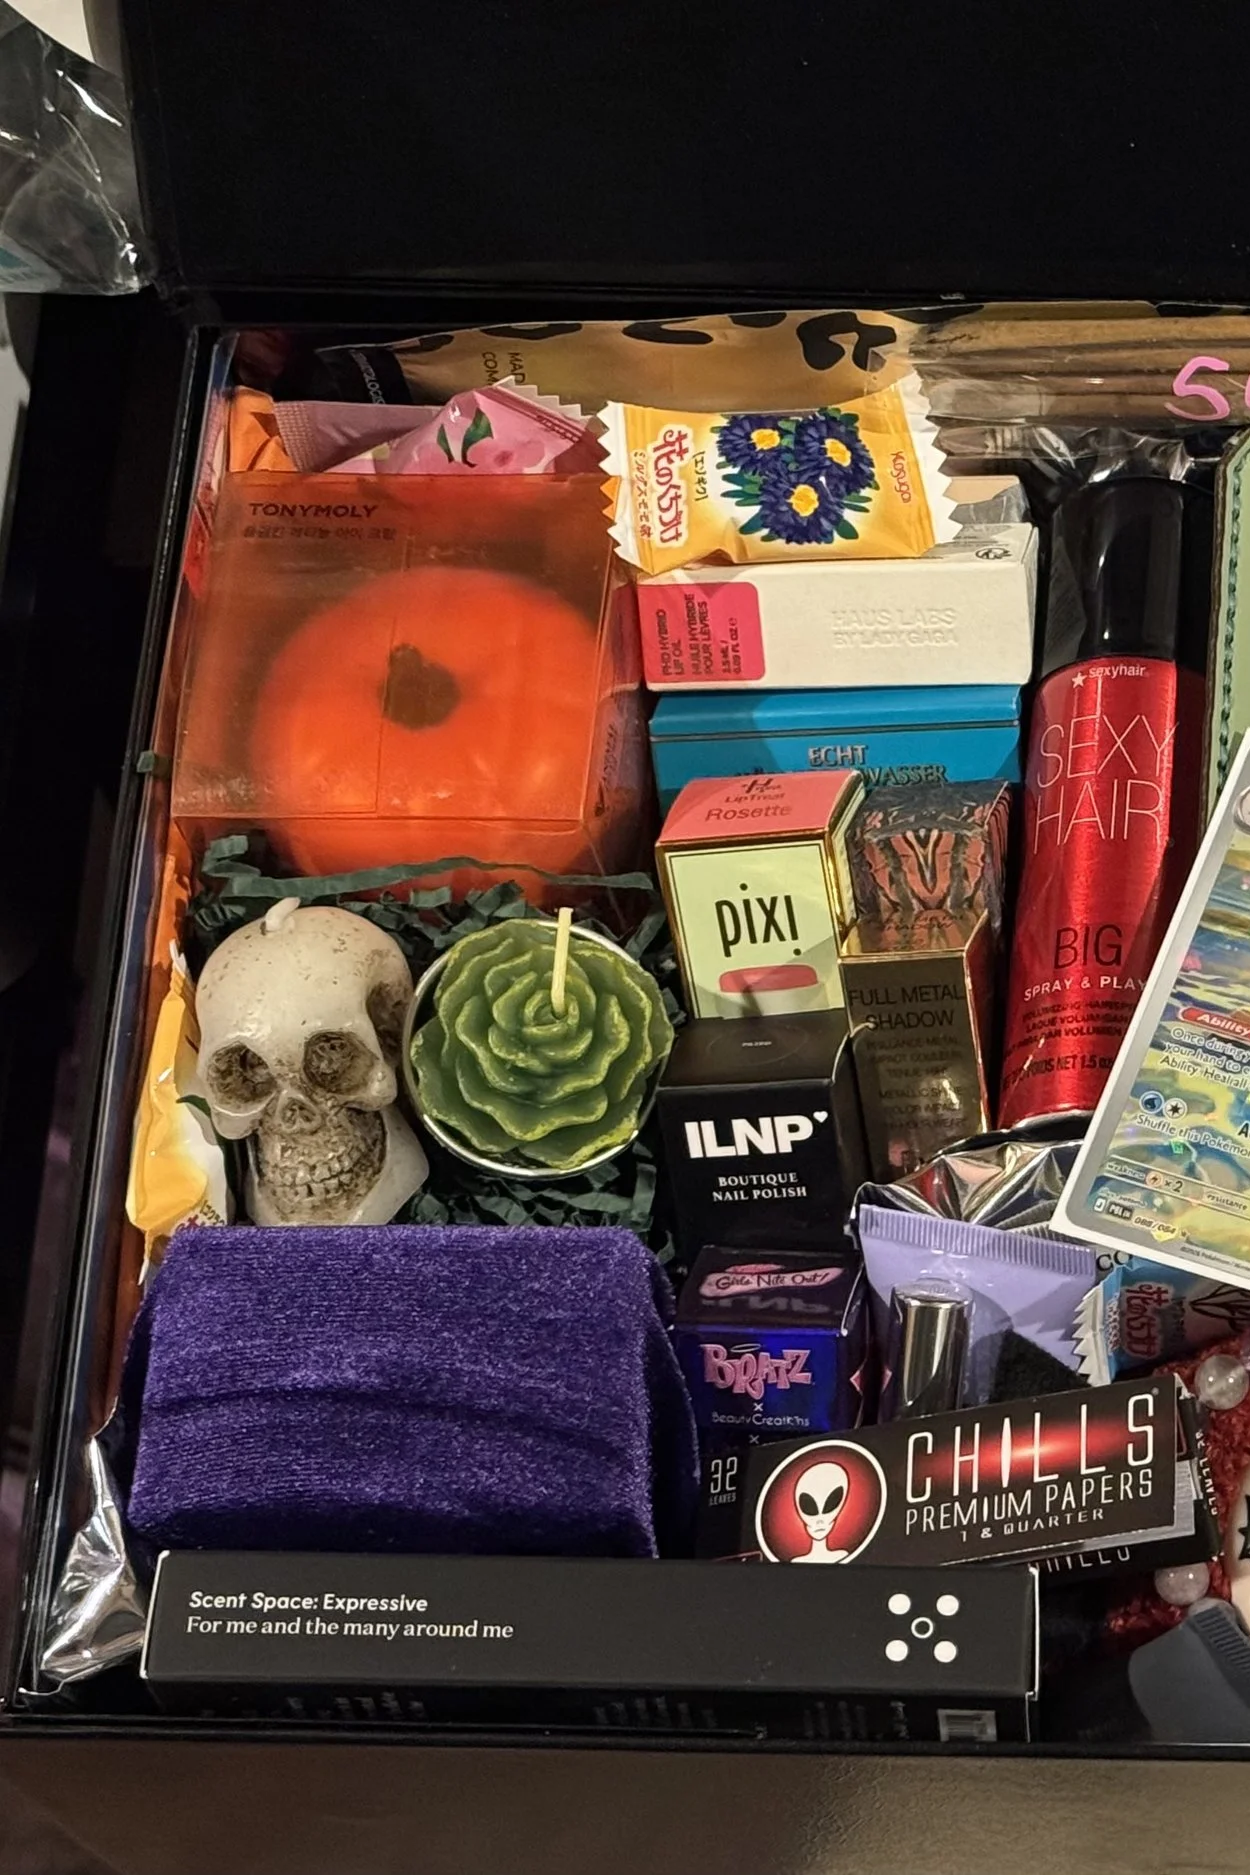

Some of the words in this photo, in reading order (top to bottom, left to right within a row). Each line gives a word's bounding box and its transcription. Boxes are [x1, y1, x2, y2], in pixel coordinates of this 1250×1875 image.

[249, 502, 379, 518] TONYMOLY
[1088, 663, 1146, 680] sexyhair
[808, 744, 869, 768] ECHT
[1036, 713, 1180, 790] SEXY
[704, 804, 793, 822] Rosette
[1033, 780, 1166, 856] HAIR
[714, 883, 802, 958] pixi
[1053, 924, 1125, 971] BIG
[848, 987, 898, 1007] FULL
[900, 984, 967, 1003] METAL
[1023, 977, 1074, 1002] SPRAY
[1080, 976, 1091, 989] &
[1100, 975, 1148, 991] PLAY
[865, 1010, 955, 1032] SHADOW
[1164, 1041, 1195, 1057] your
[1195, 1048, 1225, 1068] hand
[1226, 1060, 1241, 1073] to
[1172, 1027, 1205, 1047] Once
[1206, 1037, 1246, 1062] during
[684, 1113, 814, 1160] ILNP
[1136, 1113, 1177, 1136] Shuffle
[1177, 1126, 1200, 1143] this
[717, 1171, 799, 1188] BOUTIQUE
[712, 1188, 756, 1203] NAIL
[760, 1185, 809, 1201] POLISH
[715, 1276, 753, 1291] Girls
[905, 1392, 1157, 1505] CHILLS
[708, 1456, 739, 1495] 32
[905, 1491, 1033, 1536] PREMIUM
[1045, 1467, 1154, 1513] PAPERS
[980, 1525, 993, 1541] &
[1003, 1507, 1105, 1537] QUARTER
[188, 1590, 249, 1611] Scent
[251, 1592, 320, 1615] Space:
[322, 1592, 429, 1616] Expressive
[186, 1615, 223, 1635] For
[225, 1618, 259, 1636] me
[260, 1616, 302, 1637] and
[304, 1616, 340, 1637] the
[342, 1620, 400, 1642] many
[403, 1619, 479, 1640] around
[481, 1621, 515, 1640] me
